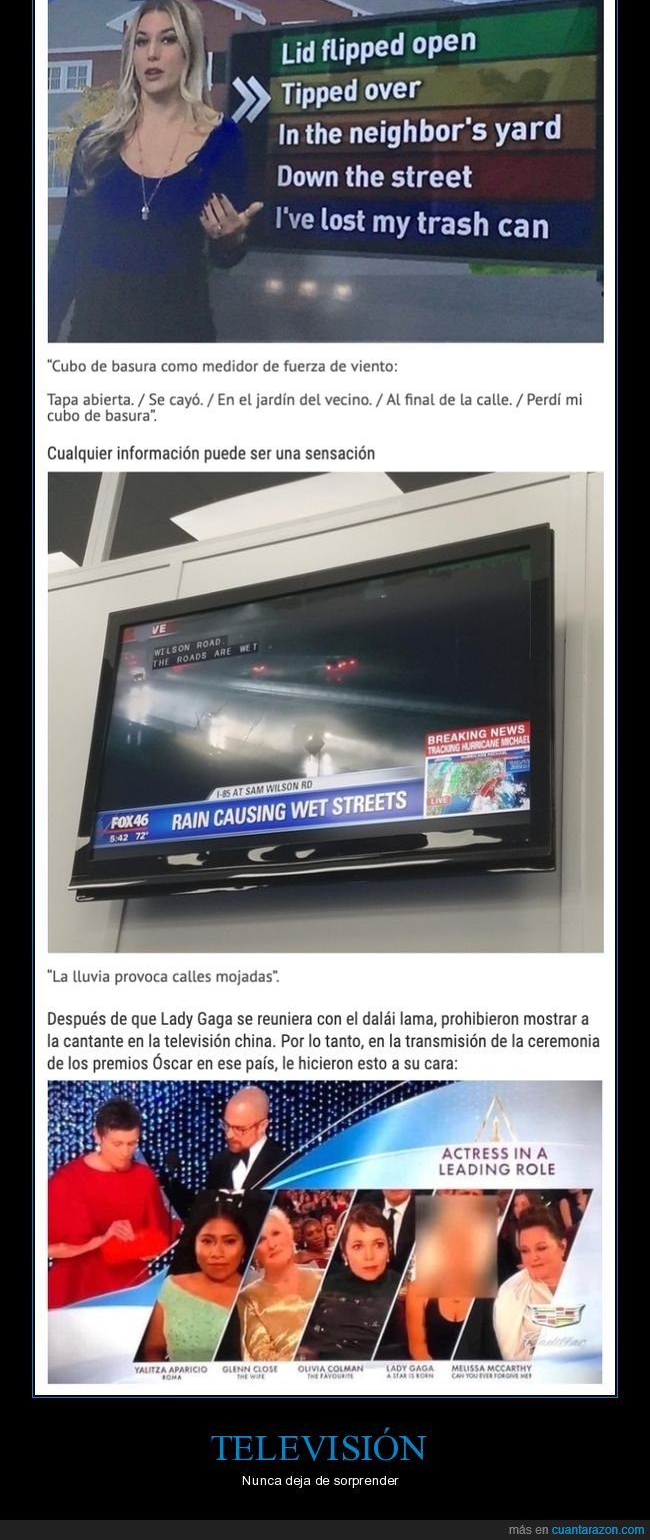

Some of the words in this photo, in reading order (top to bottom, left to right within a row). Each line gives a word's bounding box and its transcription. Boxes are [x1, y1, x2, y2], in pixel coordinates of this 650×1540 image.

[281, 41, 315, 65] Lid
[321, 32, 405, 66] flipped
[412, 31, 476, 59] open
[281, 75, 357, 109] Tipped
[364, 79, 422, 101] over
[277, 165, 339, 187] Down
[345, 165, 385, 187] the
[391, 165, 473, 188] street
[427, 729, 487, 745] BREAKING
[490, 724, 525, 737] NEWS
[171, 809, 209, 831] RAIN
[213, 803, 286, 828] CAUSING
[291, 798, 329, 819] WET
[332, 790, 407, 816] STREETS
[109, 833, 128, 844] 5:42
[441, 1147, 509, 1160] ACTRESS
[514, 1147, 531, 1160] IN
[536, 1147, 549, 1160] A
[439, 1163, 511, 1176] LEADING
[516, 1163, 556, 1176] ROLE
[386, 1364, 407, 1373] LADY
[408, 1364, 435, 1373] GAGA
